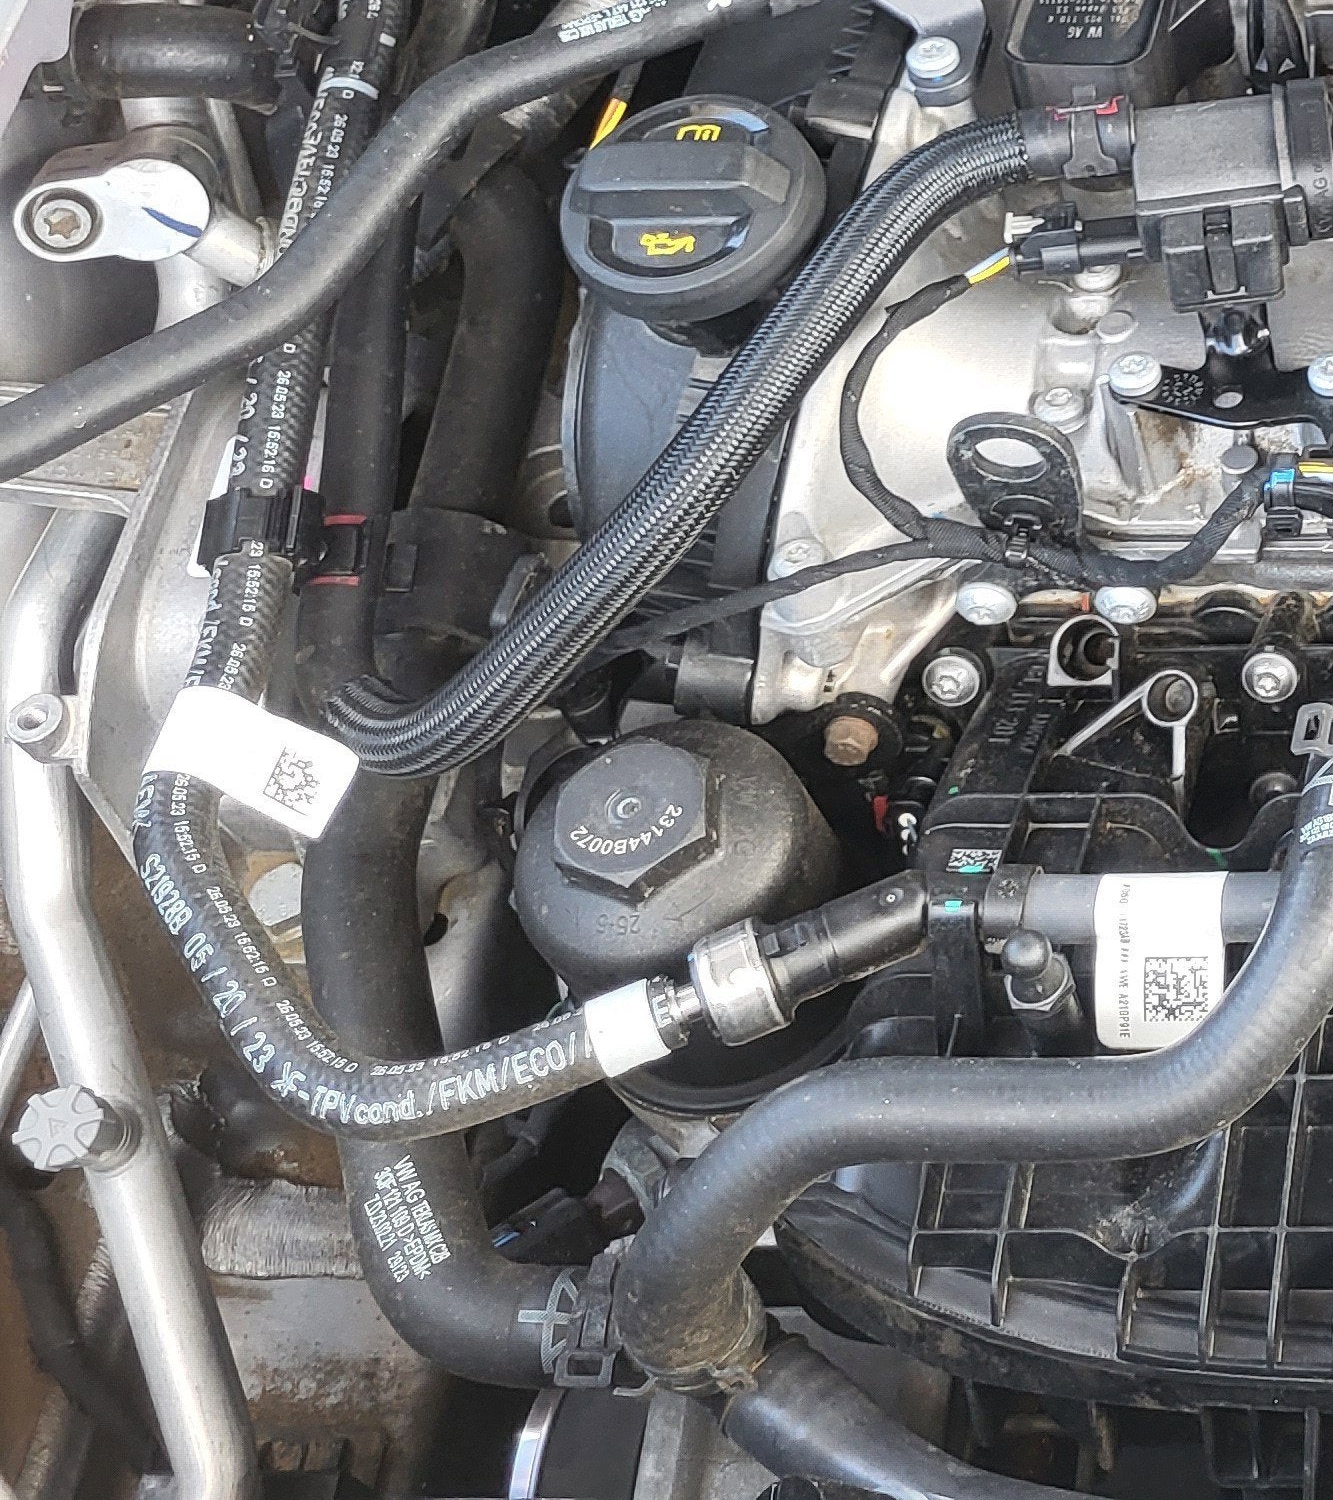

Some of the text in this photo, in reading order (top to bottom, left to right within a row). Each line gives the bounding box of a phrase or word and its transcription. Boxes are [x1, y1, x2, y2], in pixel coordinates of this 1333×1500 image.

[1066, 25, 1102, 38] VW AG
[569, 803, 682, 854] 23144B0072
[236, 1028, 281, 1075] 23
[391, 1154, 417, 1182] VW
[401, 1179, 427, 1204] AG
[380, 1186, 404, 1210] 121
[395, 1222, 416, 1237] D
[409, 1199, 438, 1235] TEKLAS
[385, 1249, 411, 1284] 29/23
